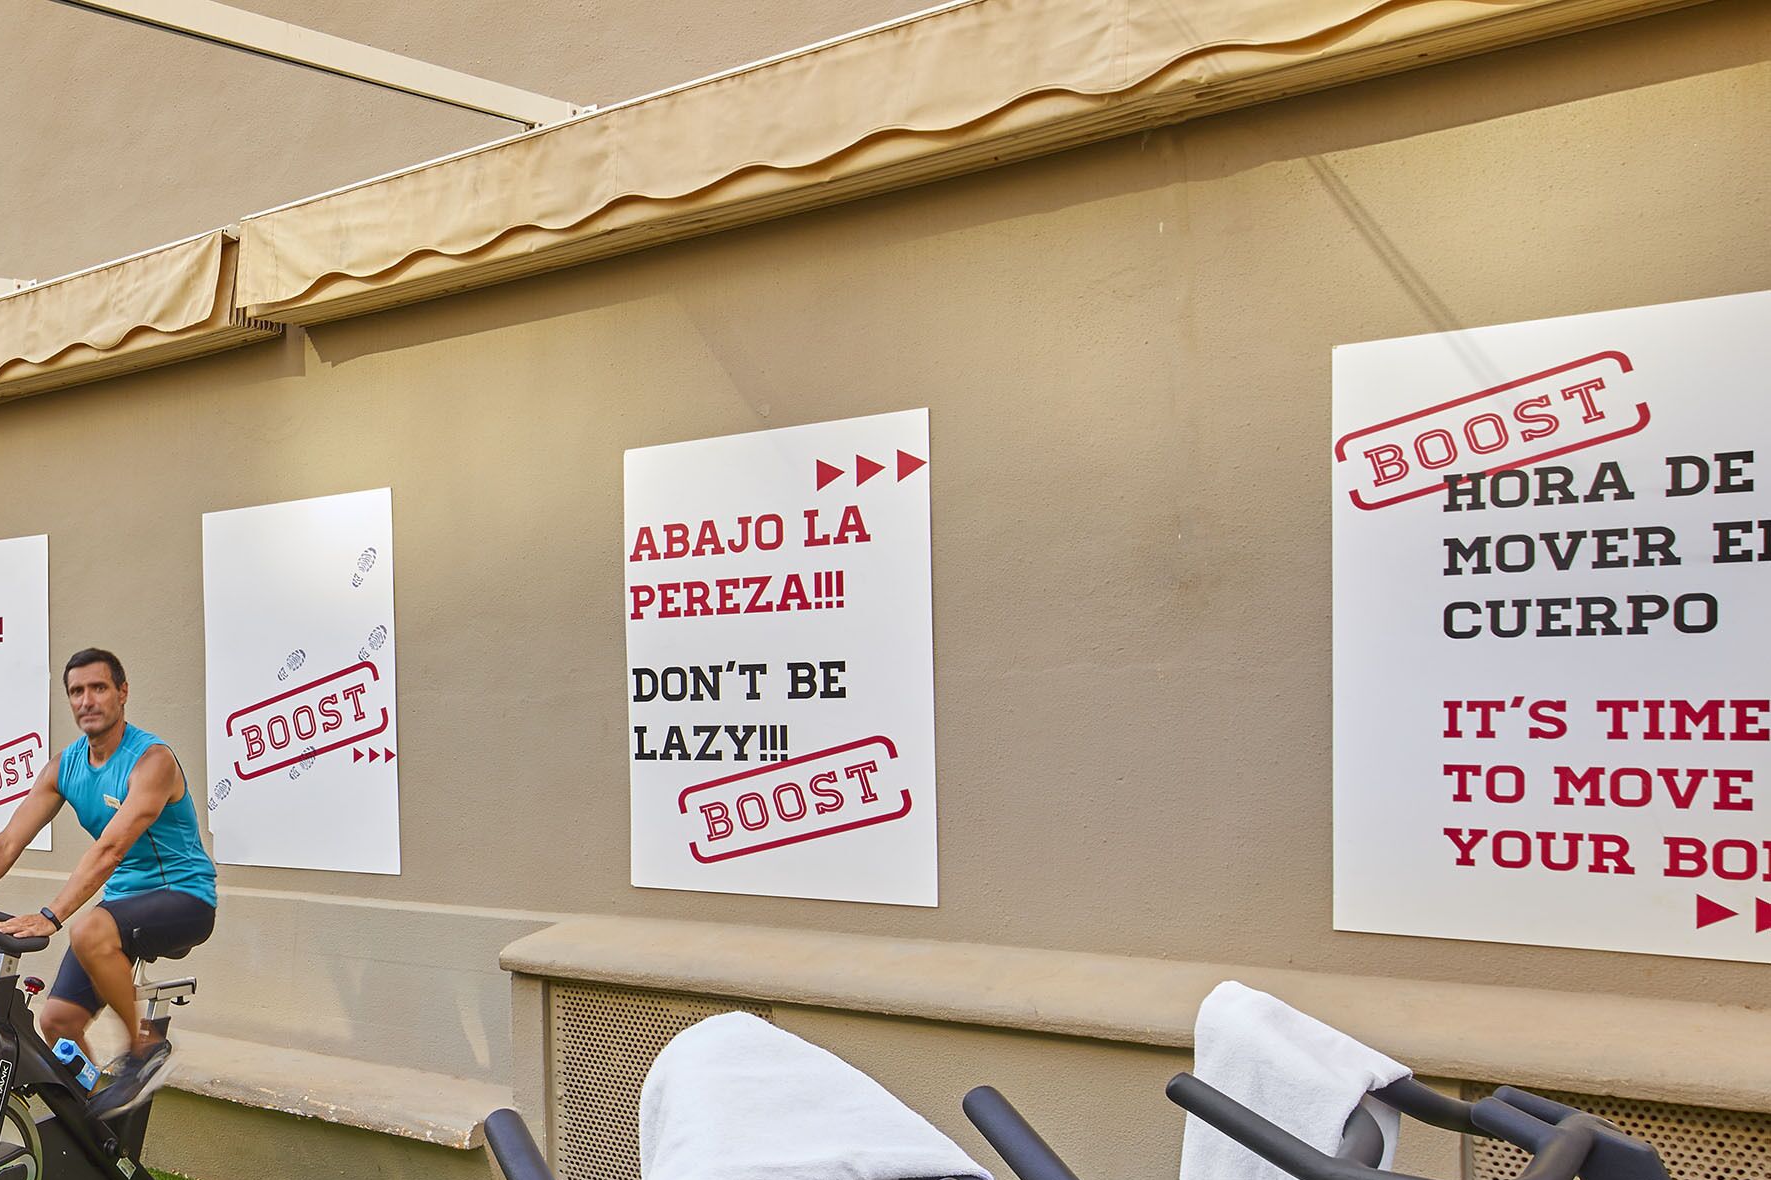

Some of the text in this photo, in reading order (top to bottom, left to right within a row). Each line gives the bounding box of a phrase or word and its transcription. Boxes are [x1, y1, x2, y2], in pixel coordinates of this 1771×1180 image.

[1363, 377, 1606, 488] BOOST
[1443, 449, 1754, 513] HORA DE
[630, 504, 871, 562] ABAJO LA
[1443, 525, 1681, 577] MOVER
[630, 570, 845, 620] PEREZA!!!
[1443, 591, 1718, 640] CUERPO
[632, 660, 847, 702] DON'T BE
[241, 683, 366, 761] BOOST
[633, 724, 789, 762] LAZY!!!
[1443, 695, 1770, 742] IT'S TIME
[700, 760, 880, 843] BOOST
[1443, 764, 1753, 812] TO MOVE
[1443, 828, 1771, 883] YOUR BO
